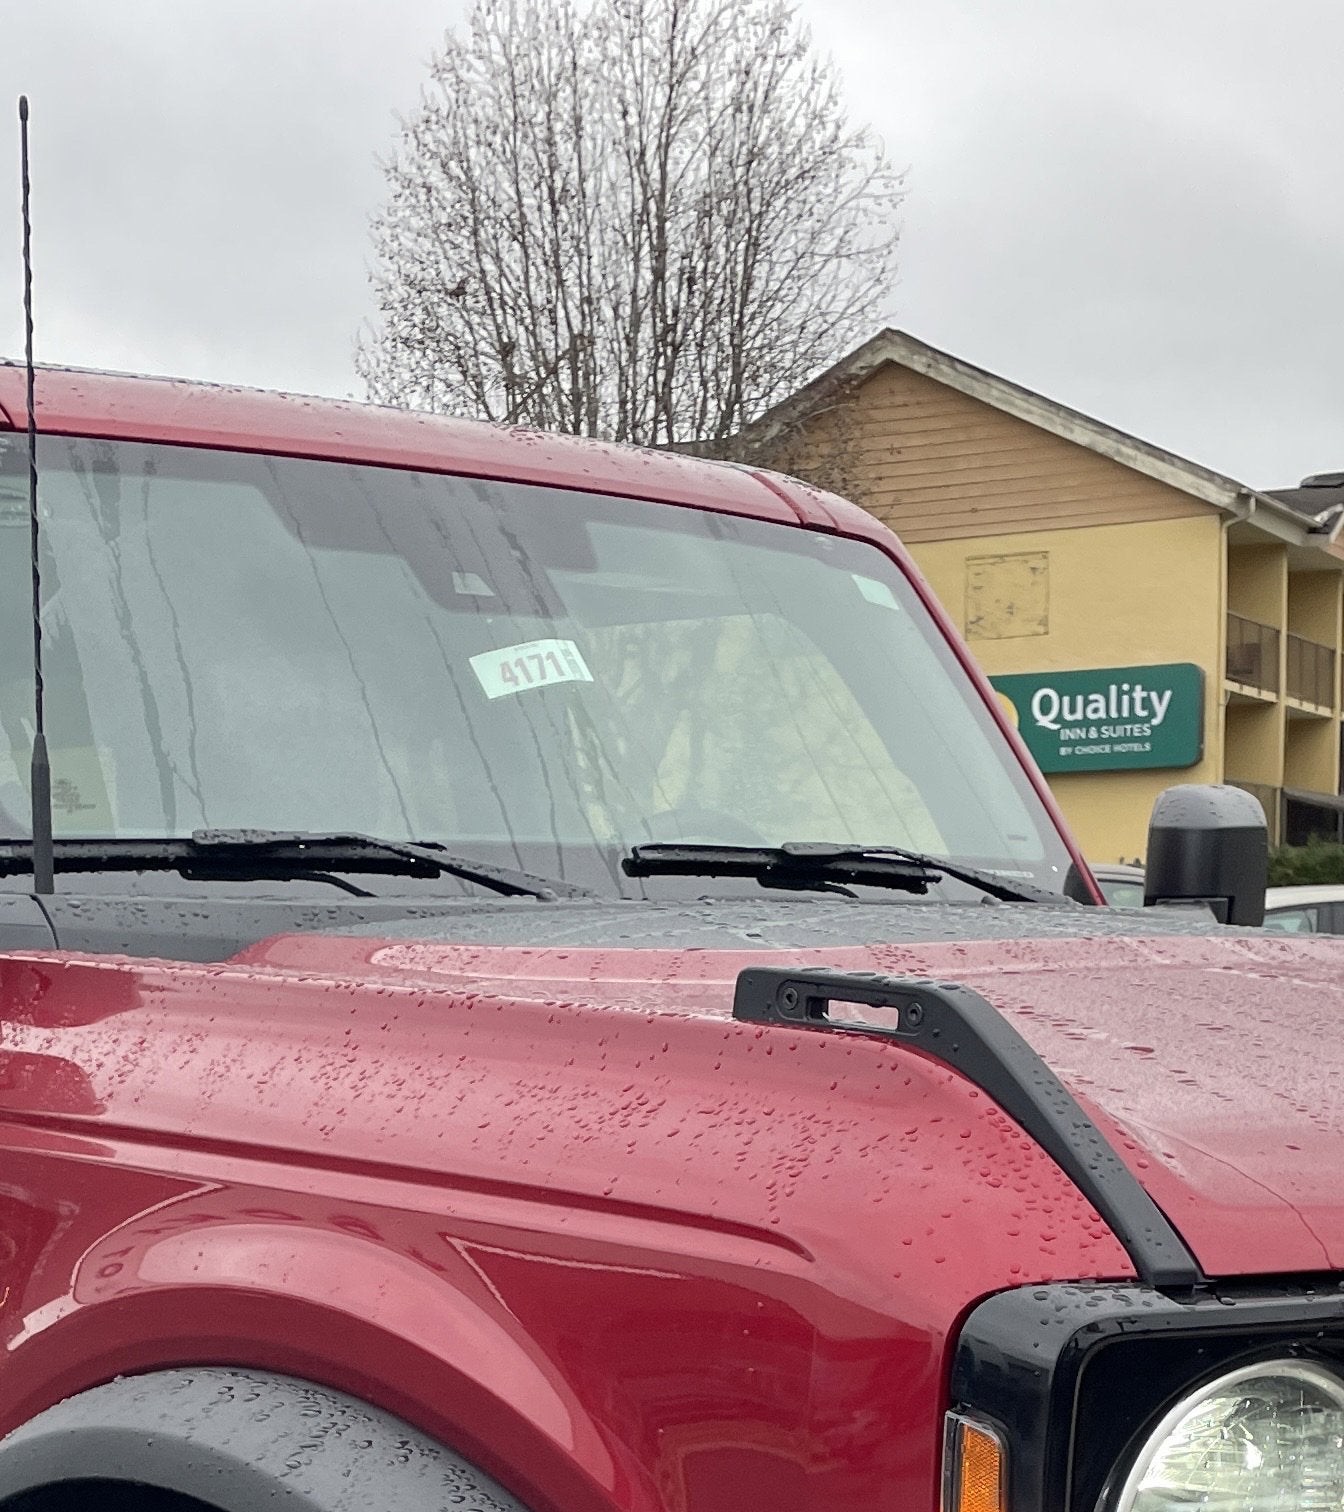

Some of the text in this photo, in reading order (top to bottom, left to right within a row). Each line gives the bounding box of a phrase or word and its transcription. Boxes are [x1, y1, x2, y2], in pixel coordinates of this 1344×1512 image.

[499, 651, 566, 686] 4171
[1030, 683, 1173, 730] Quality
[1060, 725, 1152, 740] INN & SUITES
[1076, 745, 1111, 754] CHOICE
[1113, 743, 1151, 753] HOTELS
